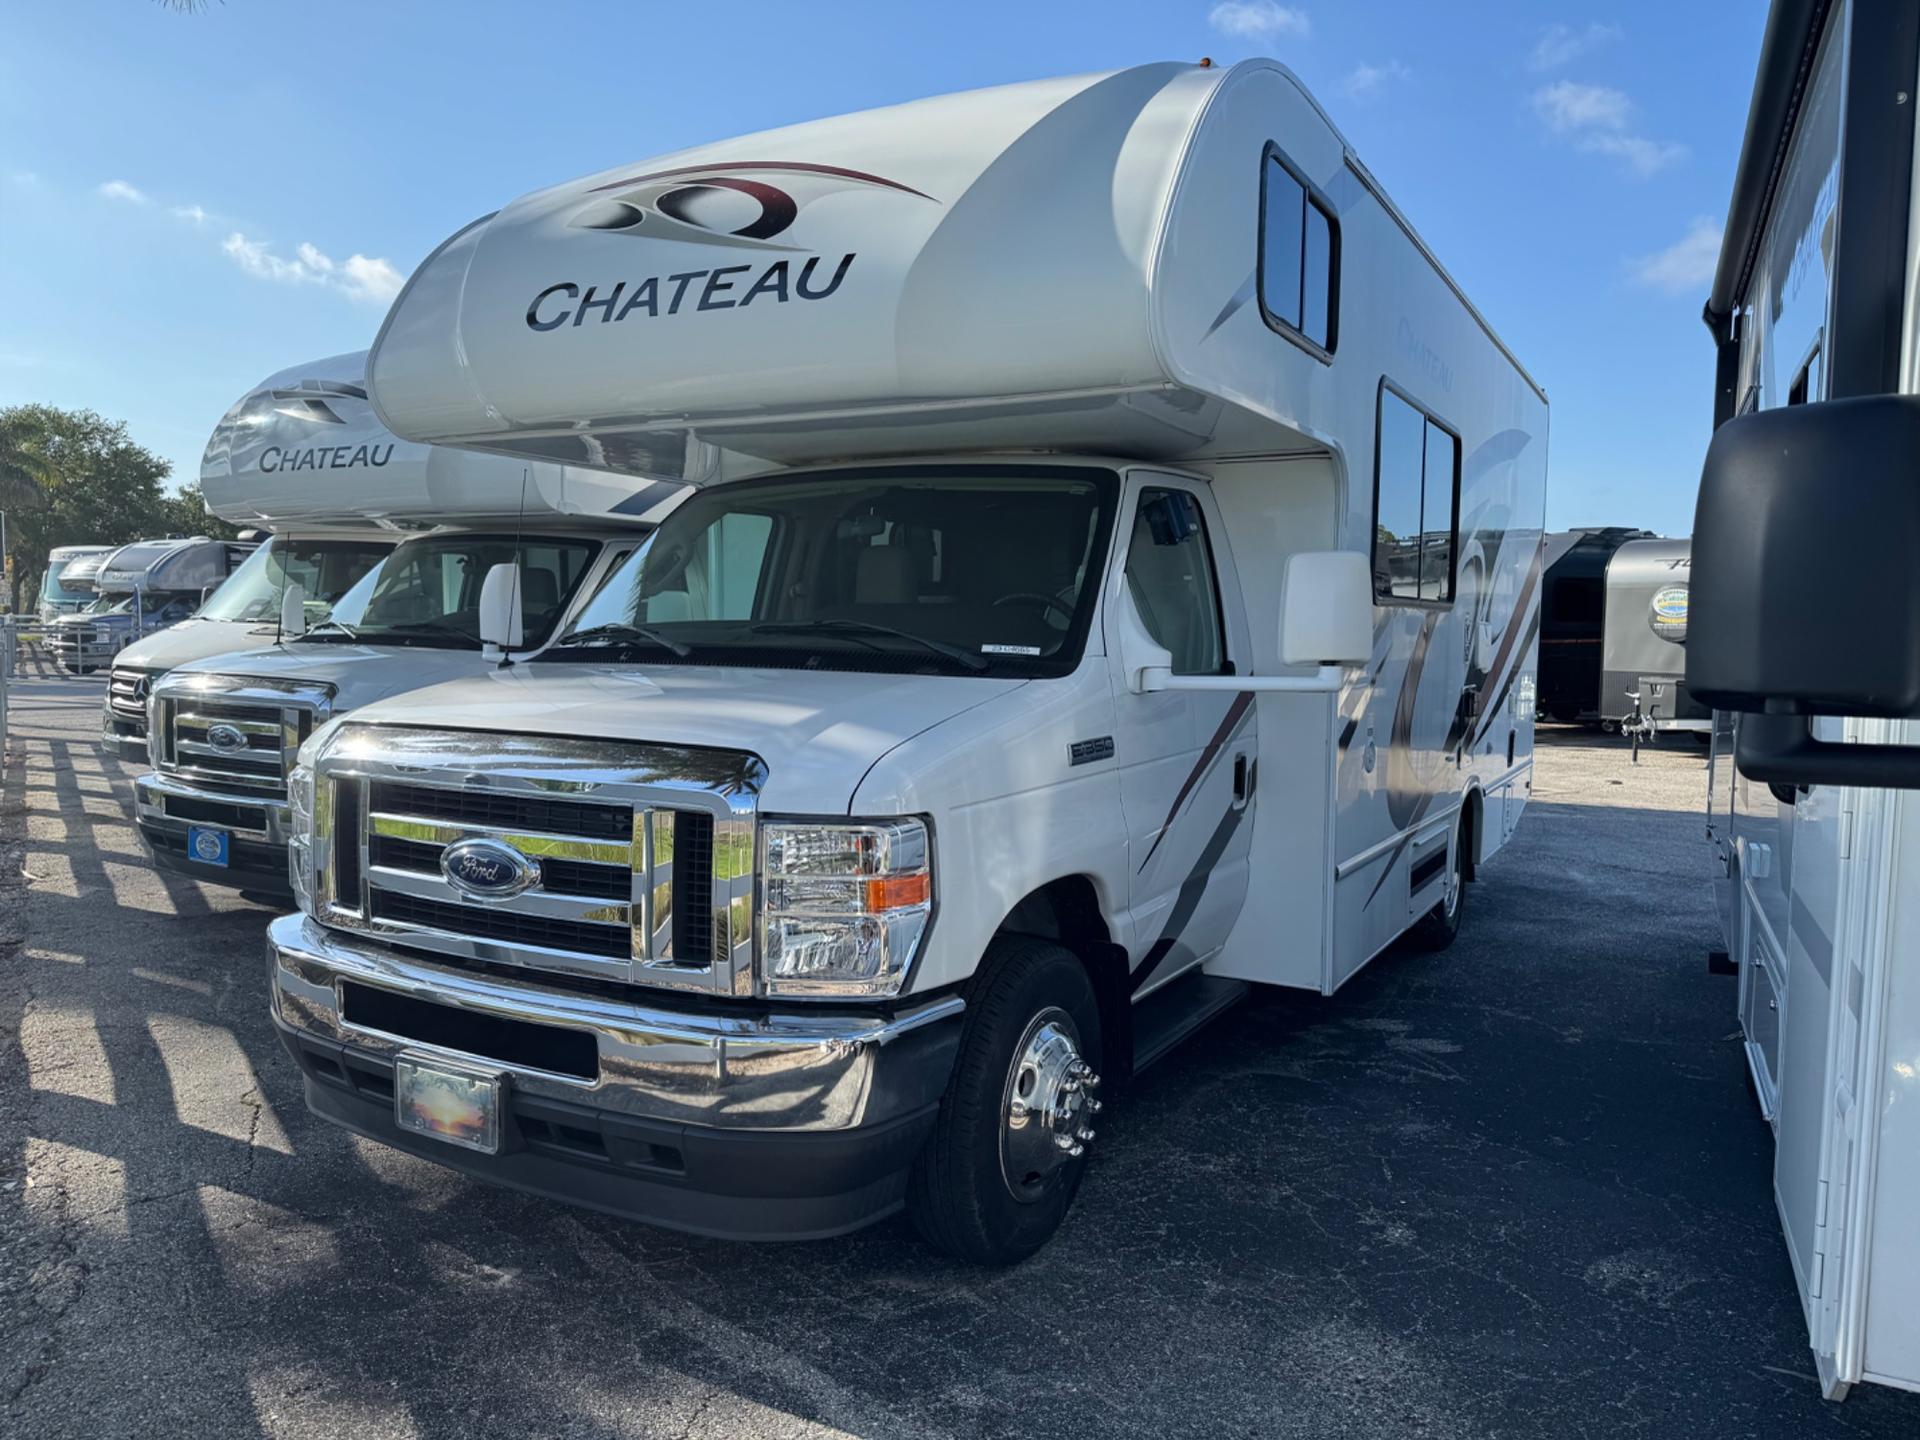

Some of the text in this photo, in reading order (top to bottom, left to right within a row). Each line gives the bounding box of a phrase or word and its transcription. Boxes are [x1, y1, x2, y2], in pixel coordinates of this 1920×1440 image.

[526, 253, 856, 332] CHATEAU
[259, 443, 395, 473] CHATEAU
[460, 854, 500, 881] Ford
